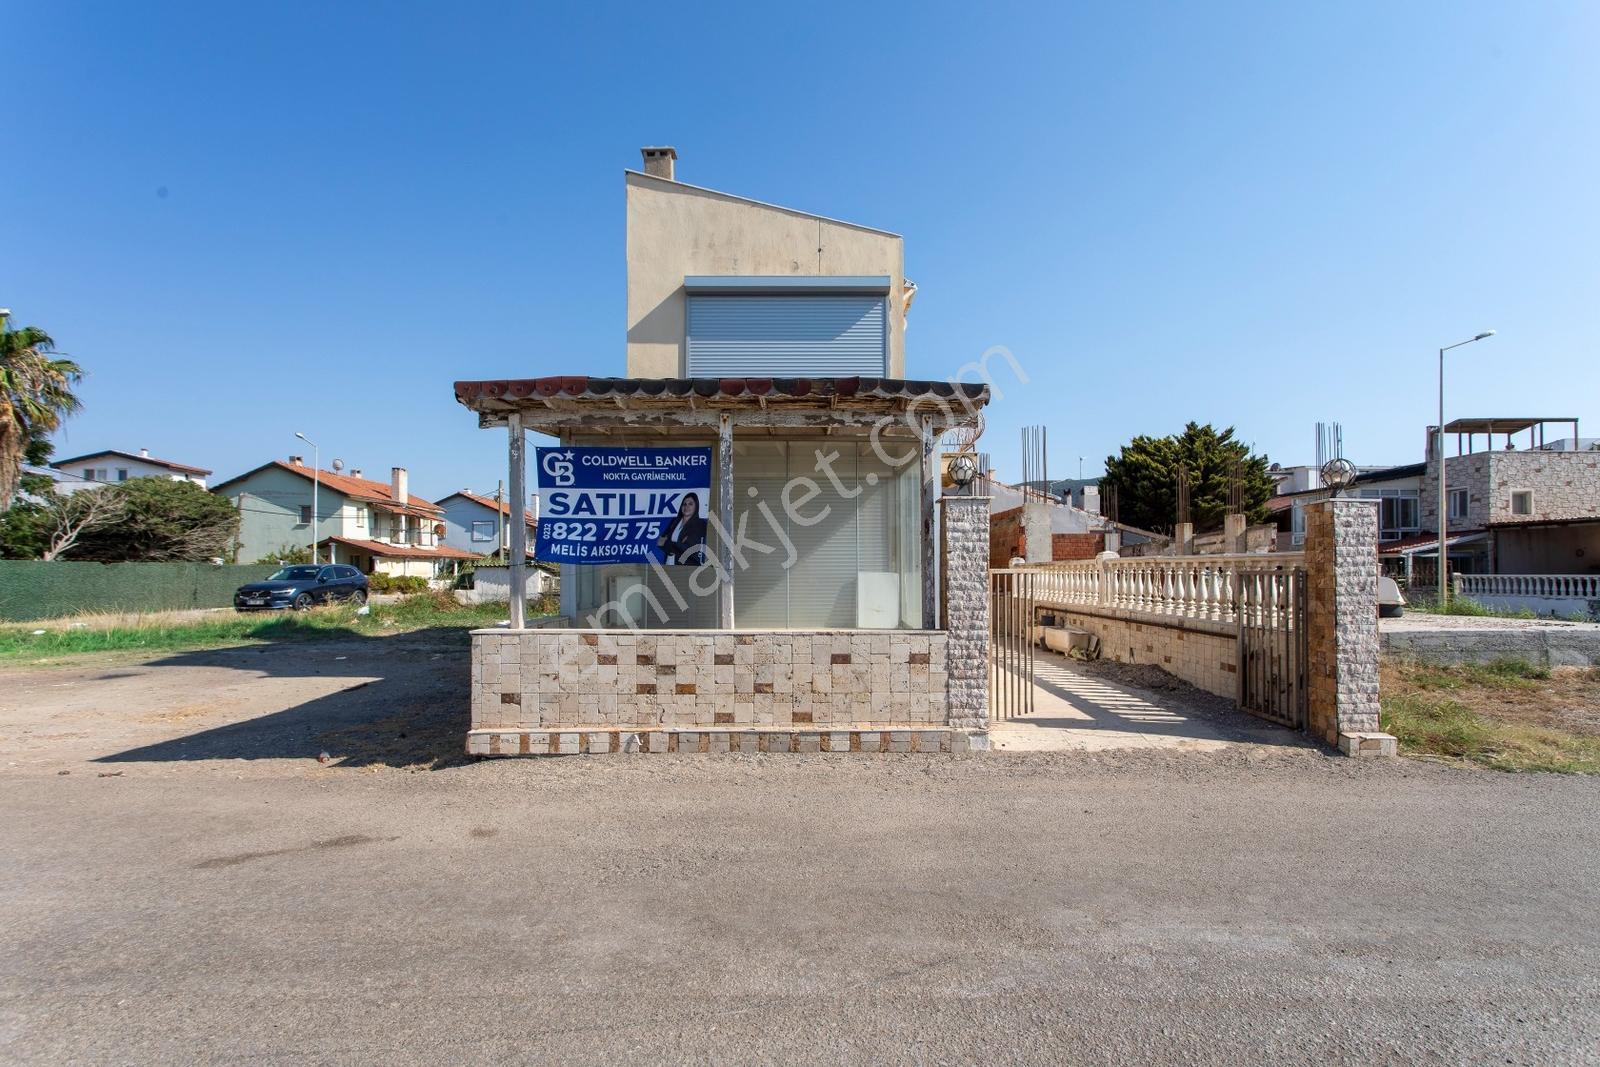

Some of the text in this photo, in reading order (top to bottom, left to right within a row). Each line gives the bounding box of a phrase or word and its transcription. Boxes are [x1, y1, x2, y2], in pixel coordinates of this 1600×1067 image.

[582, 455, 707, 467] COLDWELL BANKER
[603, 471, 686, 481] NOKTA GAYRİMENKUL
[548, 492, 681, 516] SATILIK
[552, 521, 661, 542] 822 75 75
[551, 542, 649, 557] MELİS AKSOYSAN
